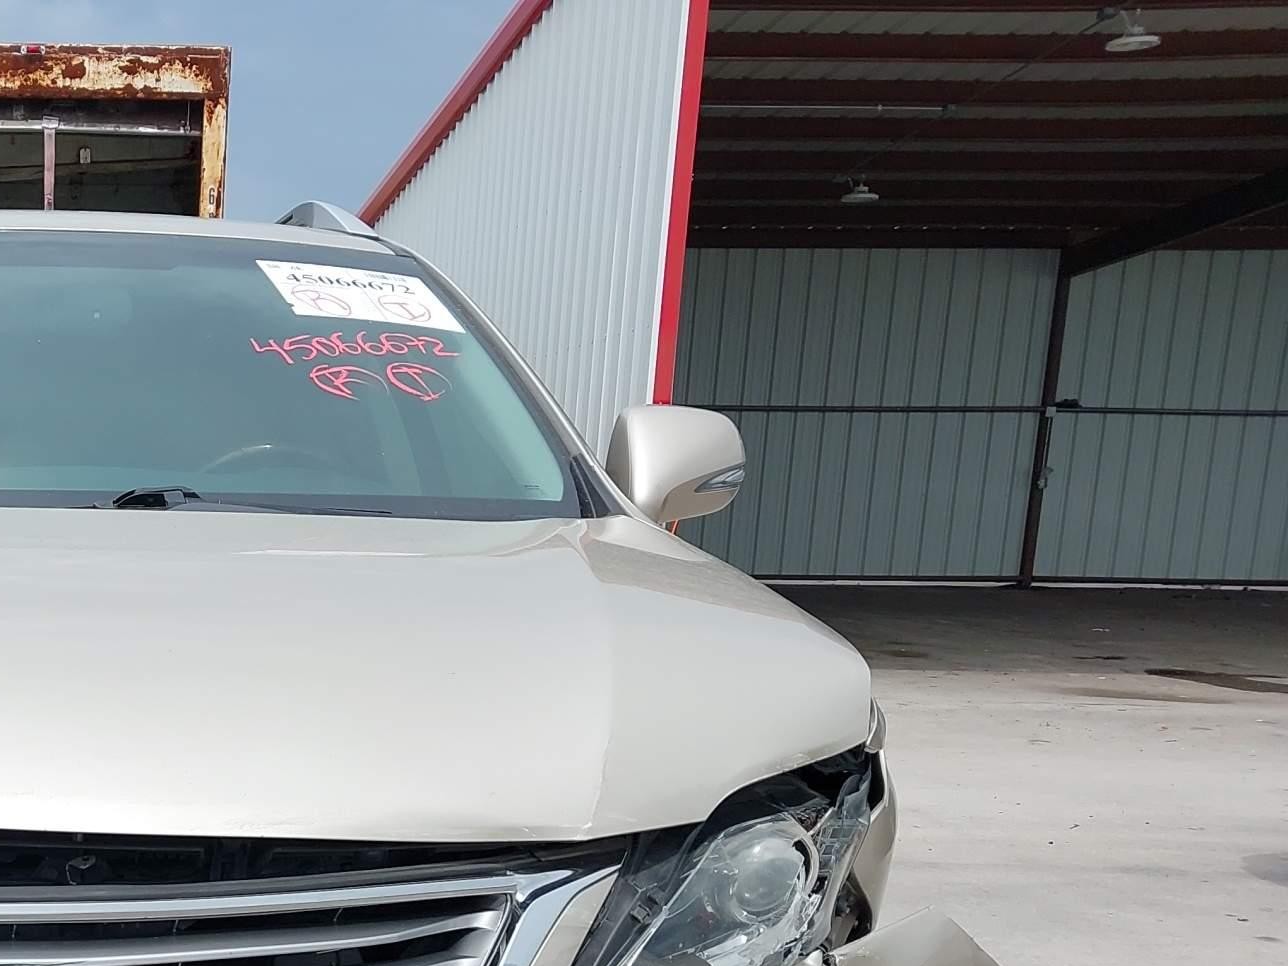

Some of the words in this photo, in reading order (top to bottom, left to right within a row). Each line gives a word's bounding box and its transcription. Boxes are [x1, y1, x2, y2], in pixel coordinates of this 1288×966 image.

[209, 187, 215, 205] 6
[286, 273, 415, 295] 45066672
[249, 331, 460, 364] 45066672
